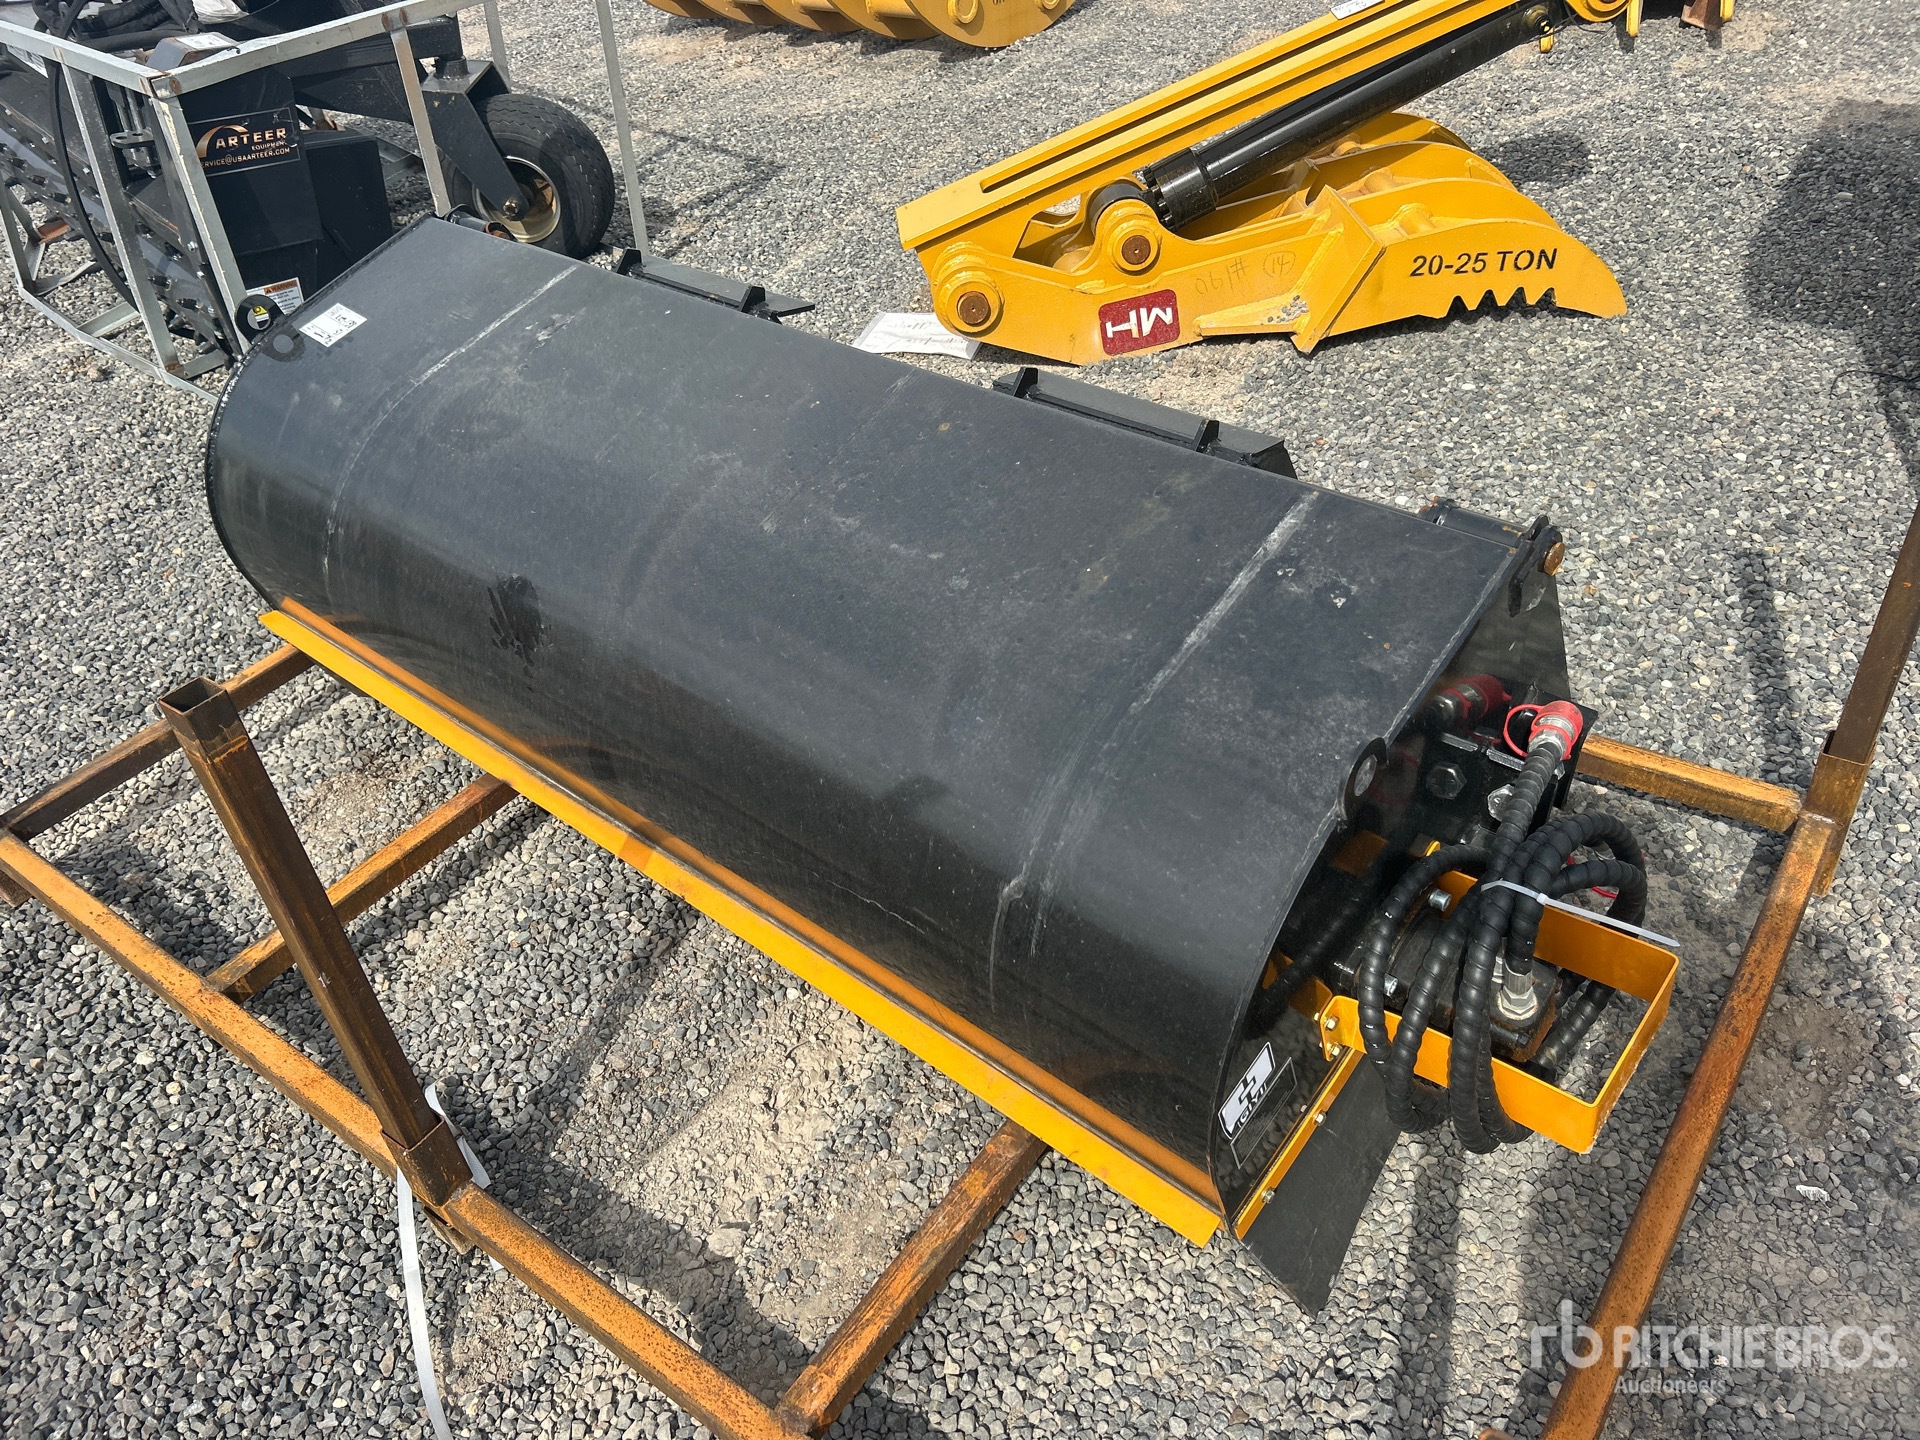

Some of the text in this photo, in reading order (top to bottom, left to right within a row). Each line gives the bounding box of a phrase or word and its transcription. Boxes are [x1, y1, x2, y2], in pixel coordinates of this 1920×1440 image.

[215, 127, 287, 150] ARTEER
[1410, 248, 1558, 277] 20-25 TON
